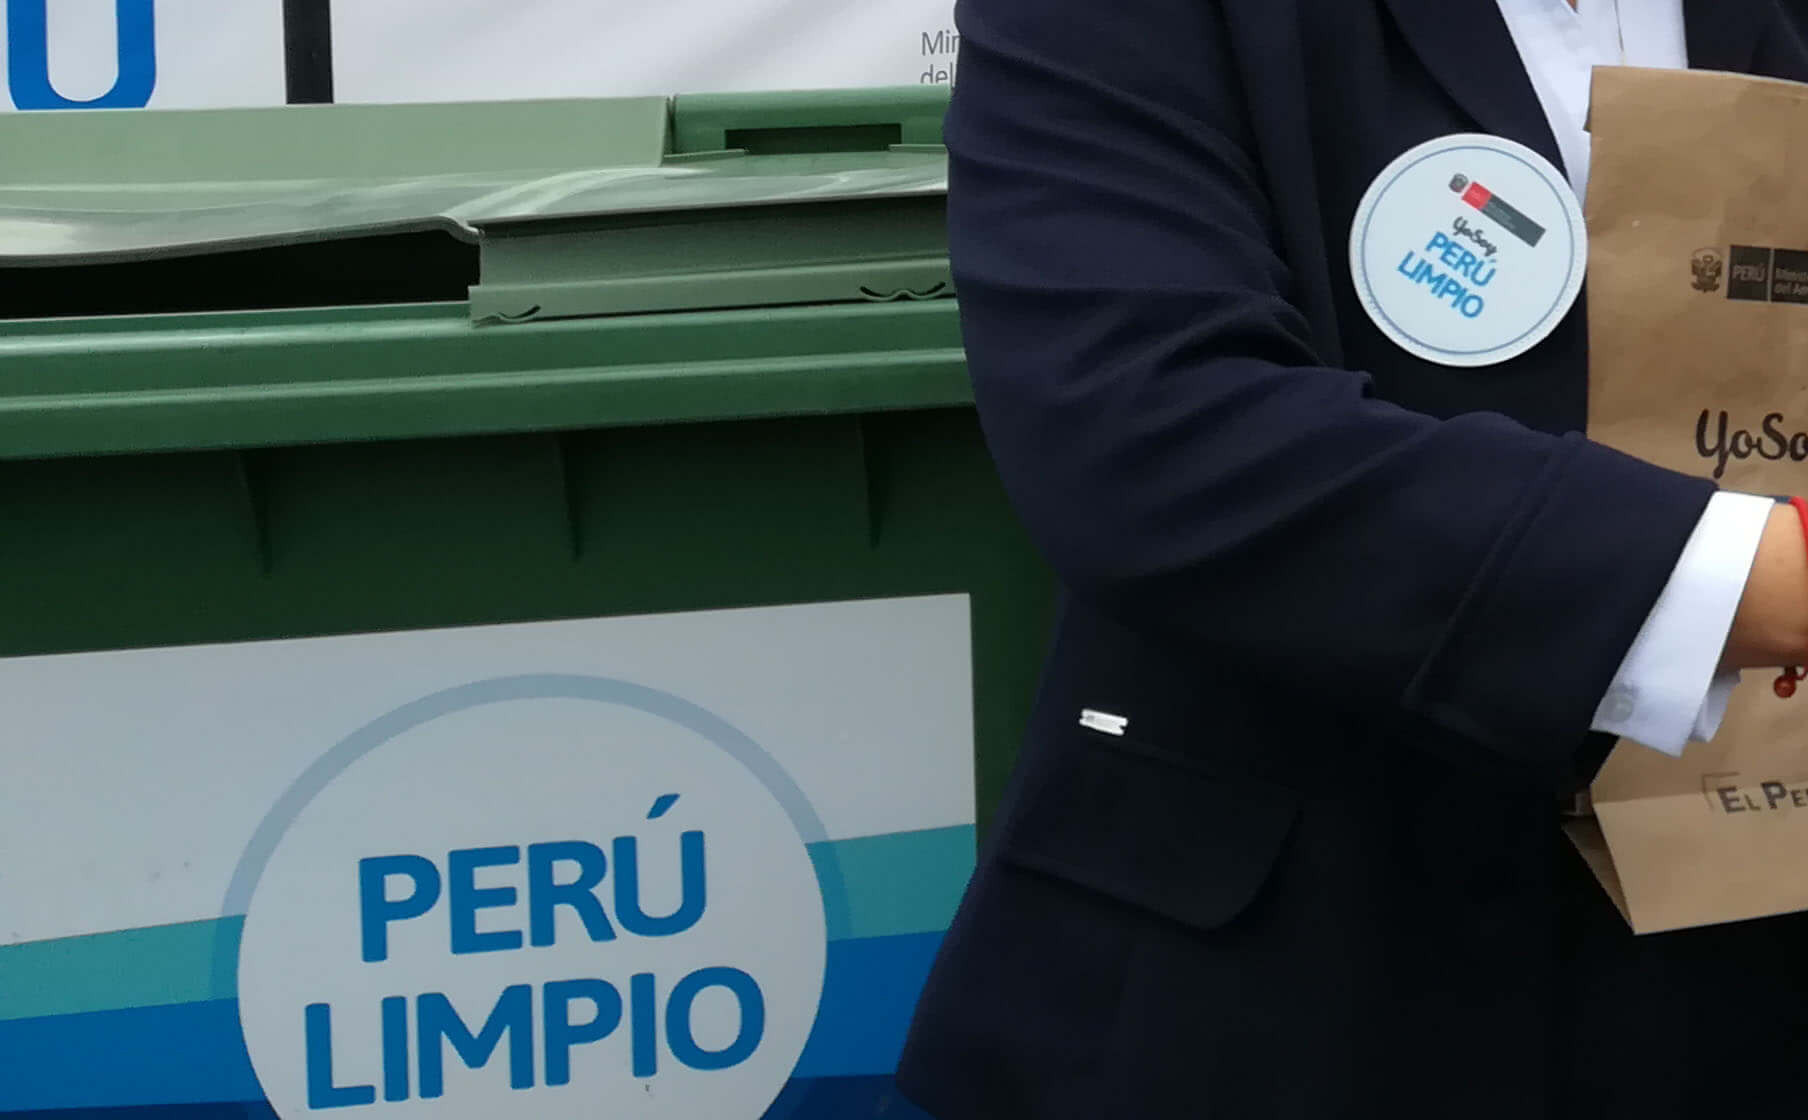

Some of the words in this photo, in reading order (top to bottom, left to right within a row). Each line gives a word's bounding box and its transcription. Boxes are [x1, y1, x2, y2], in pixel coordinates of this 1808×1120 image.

[1397, 251, 1484, 318] LIMPIO
[1425, 231, 1497, 287] PERÚ
[359, 793, 707, 963] PERÚ
[305, 965, 765, 1110] LIMPIO
